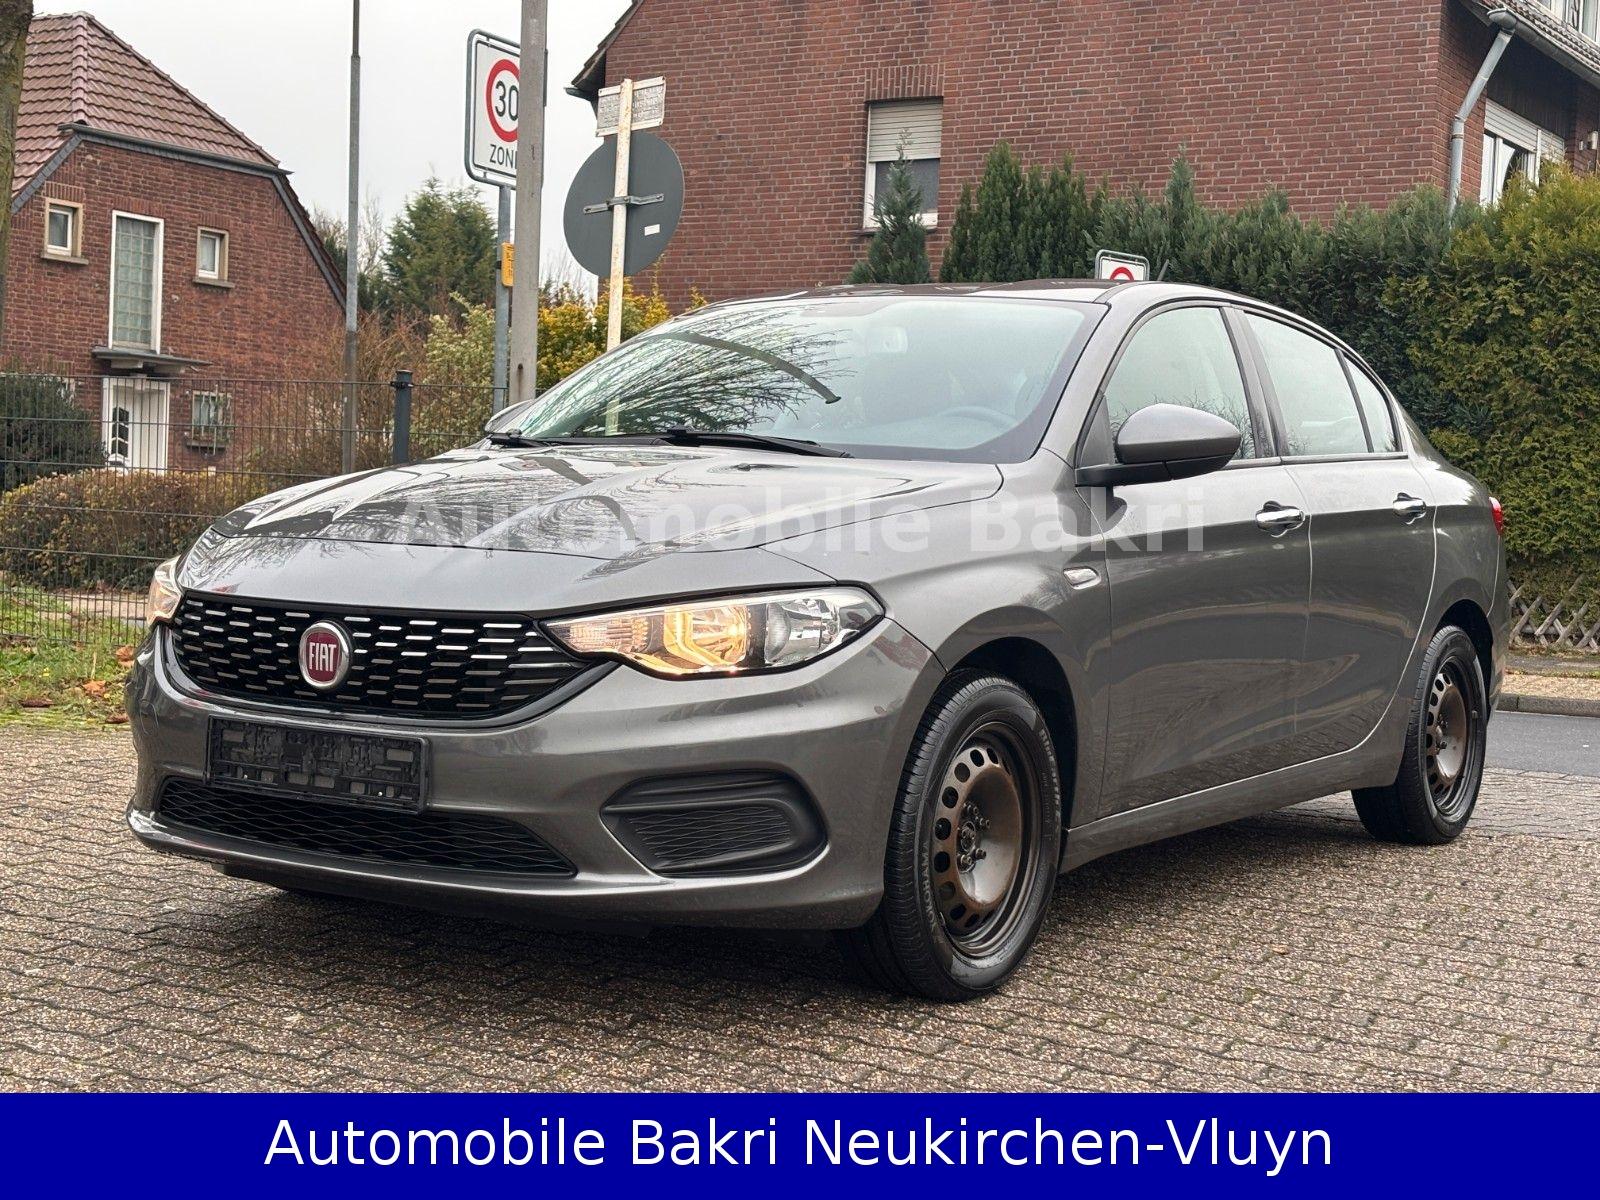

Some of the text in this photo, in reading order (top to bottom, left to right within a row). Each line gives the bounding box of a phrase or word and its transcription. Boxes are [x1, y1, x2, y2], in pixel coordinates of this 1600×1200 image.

[495, 80, 519, 121] 30
[308, 641, 338, 672] FIAT
[922, 841, 939, 933] YOKOHAMA
